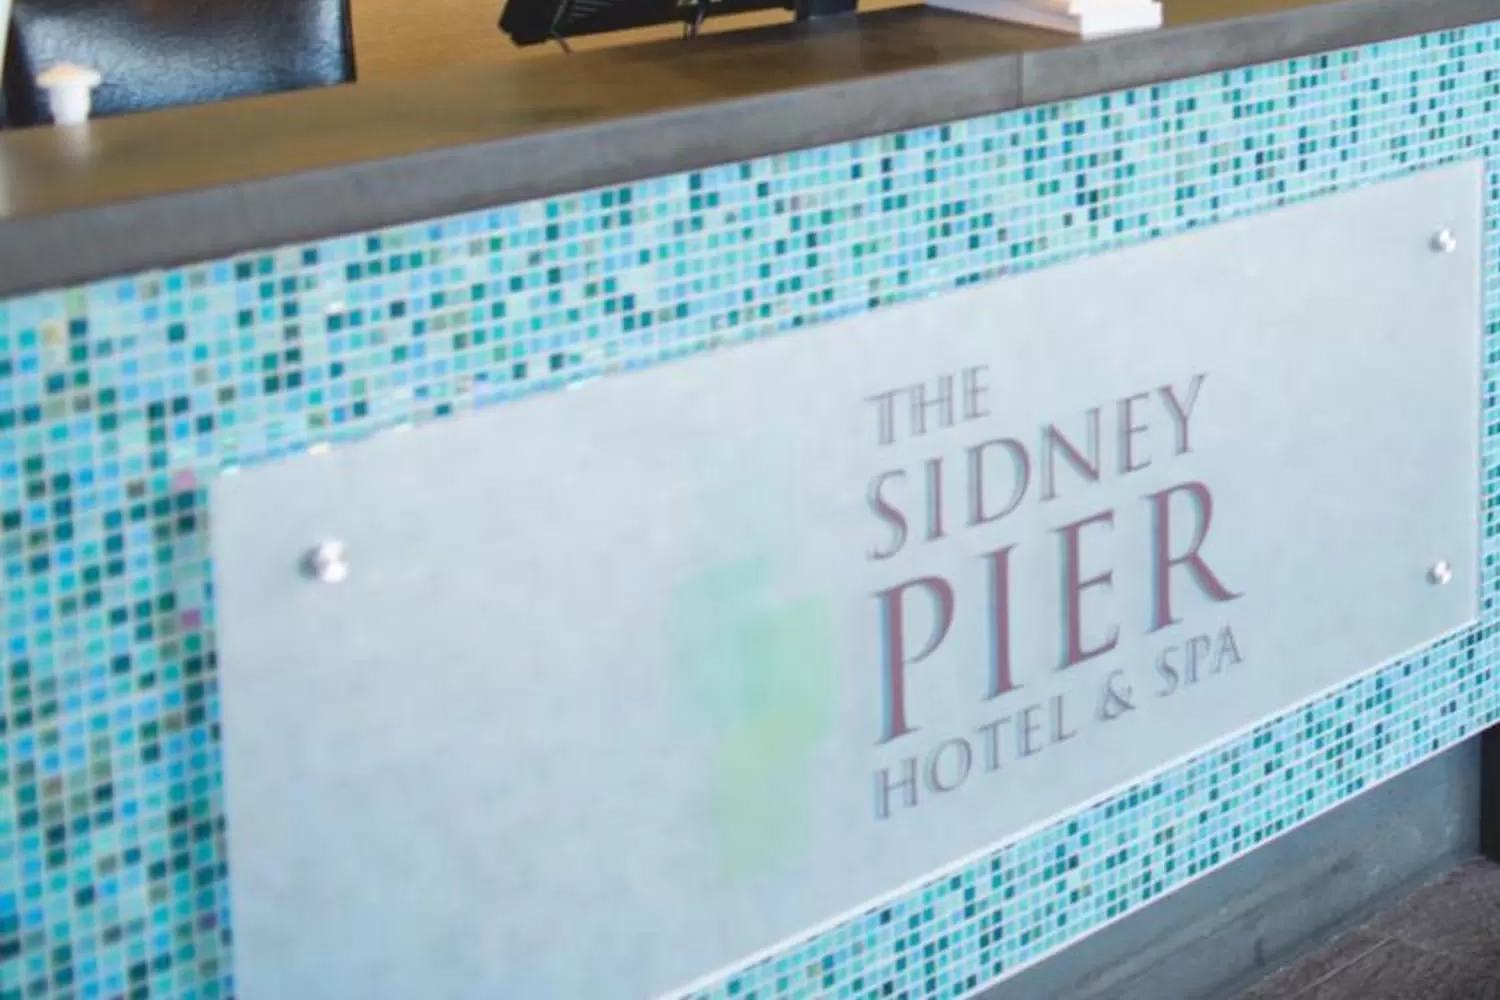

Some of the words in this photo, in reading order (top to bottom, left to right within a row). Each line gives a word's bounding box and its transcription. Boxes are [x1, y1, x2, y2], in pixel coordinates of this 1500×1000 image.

[864, 364, 991, 447] THE
[865, 373, 1208, 562] SIDNEY
[869, 480, 1246, 746] PIER
[873, 694, 1078, 821] HOTEL
[1096, 668, 1137, 723] &
[1155, 625, 1244, 698] SPA
